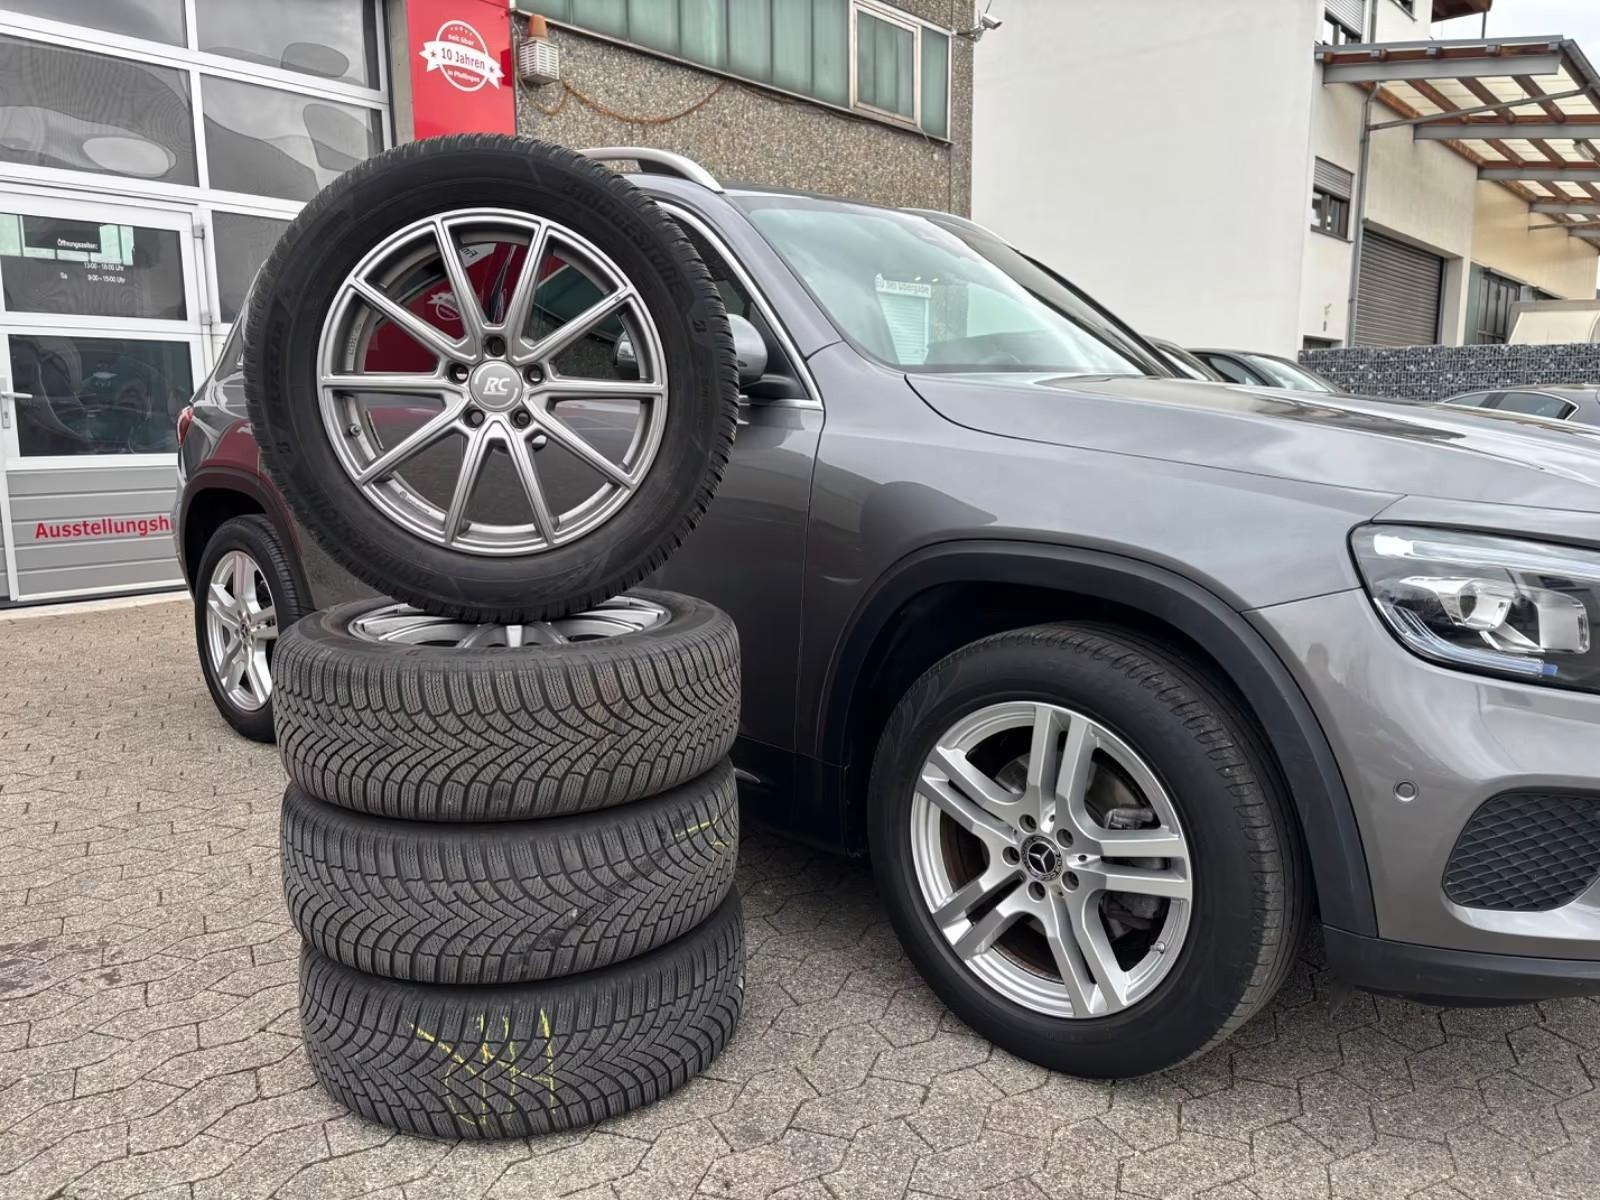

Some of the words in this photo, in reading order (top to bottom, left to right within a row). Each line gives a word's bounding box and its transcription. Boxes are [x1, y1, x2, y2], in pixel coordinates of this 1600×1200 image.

[441, 47, 452, 60] 10
[456, 51, 485, 71] Jahren
[560, 174, 684, 293] BRIDGESTONE
[483, 377, 511, 395] RC
[35, 515, 174, 539] Ausstellungsh
